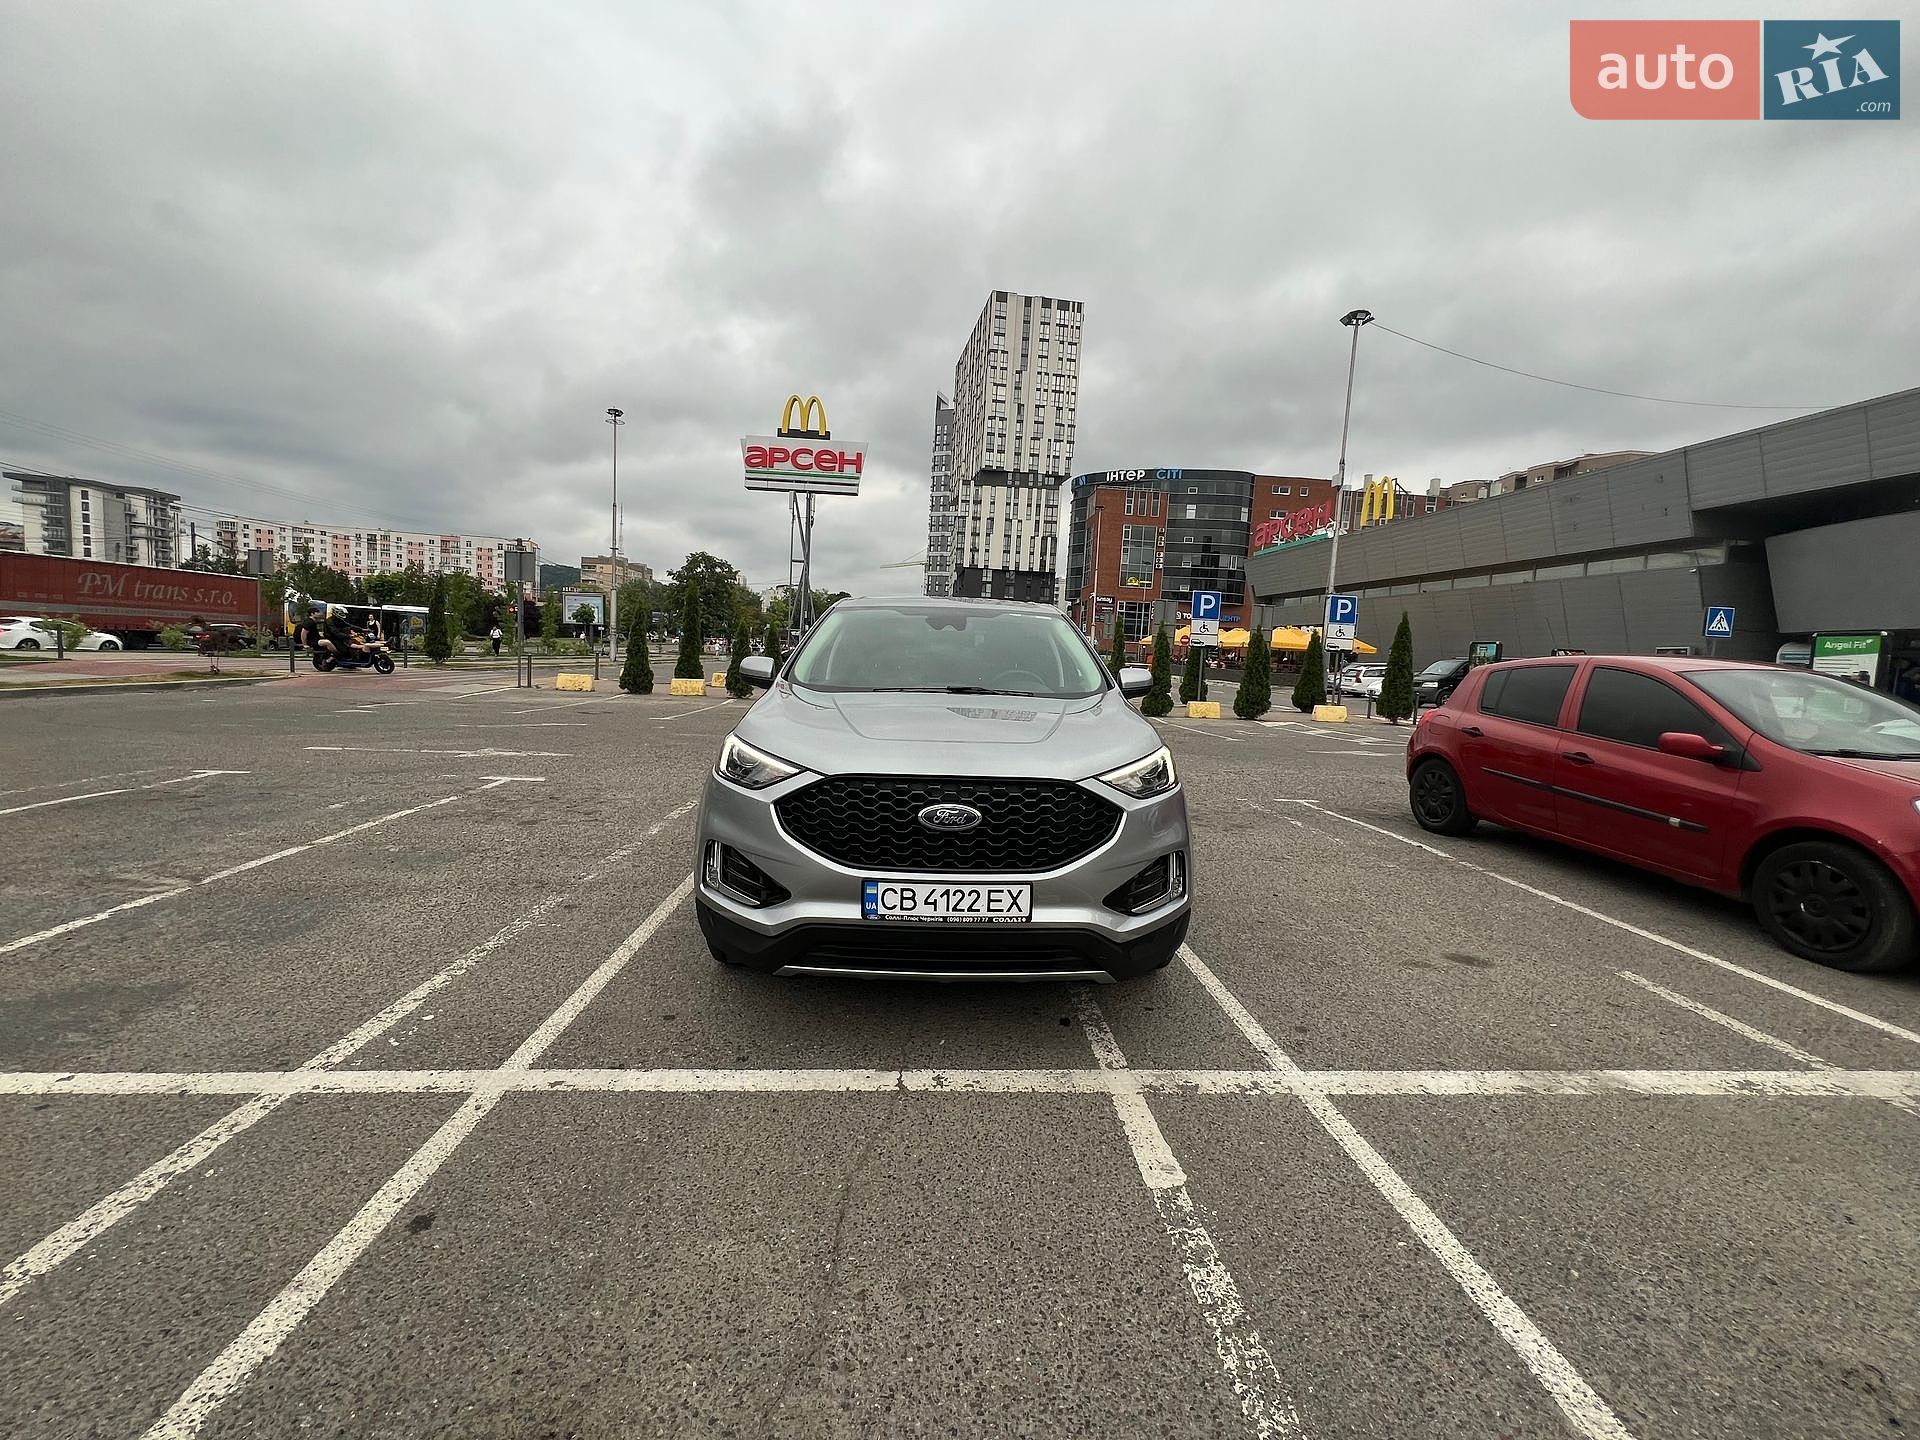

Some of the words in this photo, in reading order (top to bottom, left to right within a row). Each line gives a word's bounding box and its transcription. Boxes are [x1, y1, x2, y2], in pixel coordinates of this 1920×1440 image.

[77, 572, 129, 598] PM
[133, 579, 188, 602] trans
[1199, 594, 1216, 617] P
[1336, 599, 1352, 621] P
[1824, 641, 1852, 650] Angel
[1853, 641, 1867, 649] Fit
[933, 809, 967, 824] Ford
[866, 901, 877, 911] UA
[880, 887, 917, 911] CB
[923, 888, 981, 913] 4122
[986, 889, 1024, 913] EX
